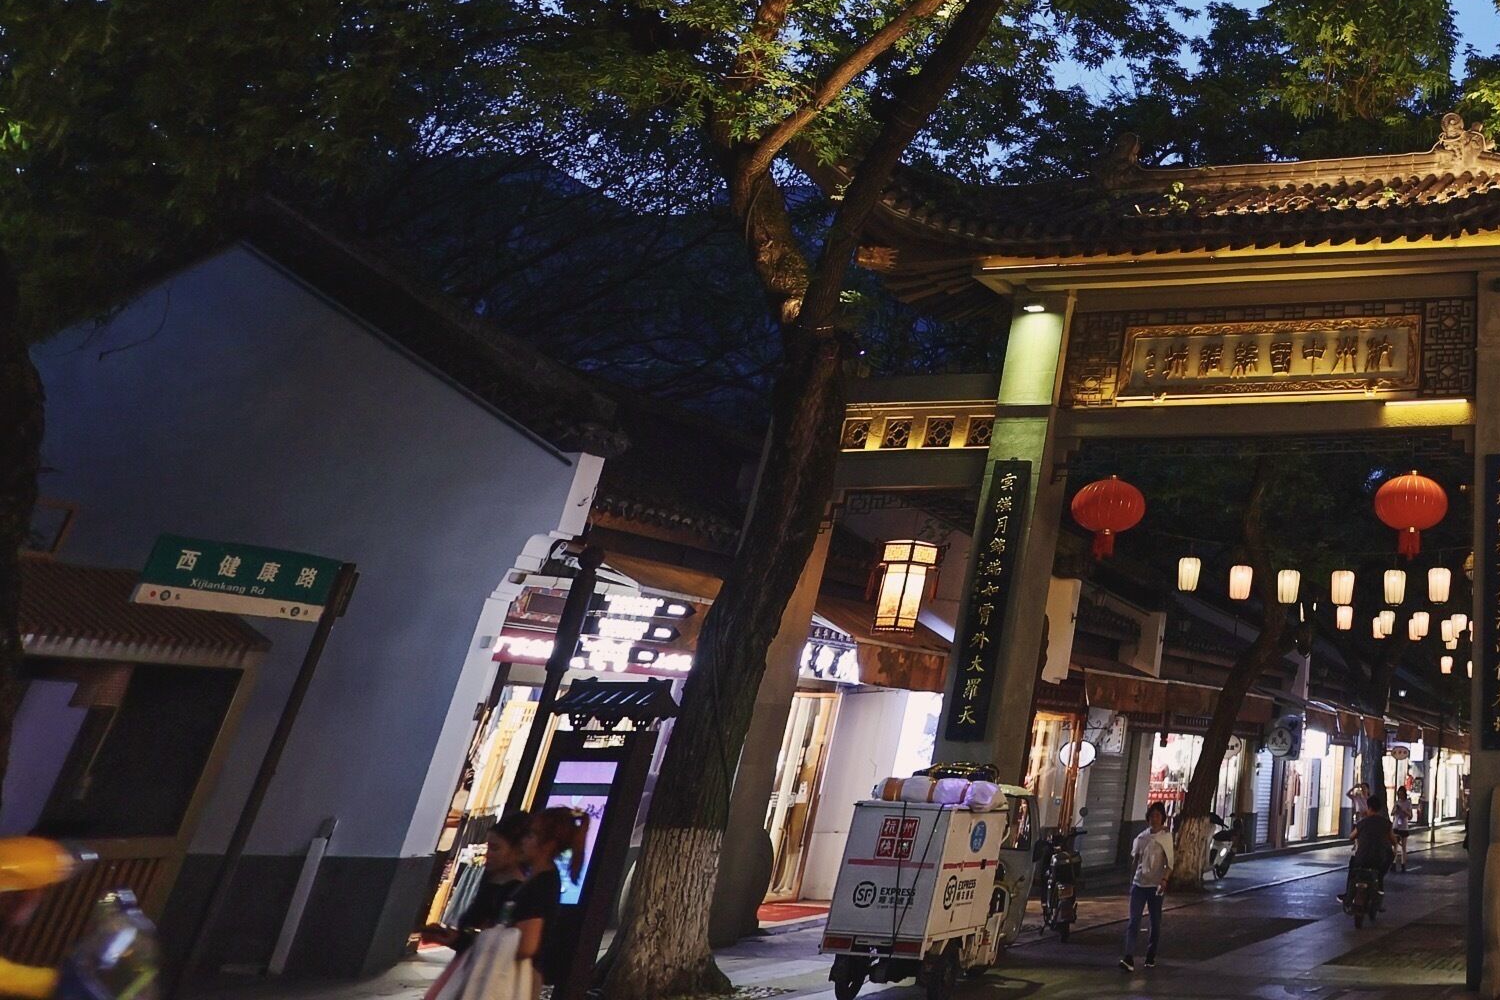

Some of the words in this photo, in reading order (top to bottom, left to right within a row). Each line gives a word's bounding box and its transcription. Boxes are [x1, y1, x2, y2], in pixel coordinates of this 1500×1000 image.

[175, 549, 318, 589] 西健康路
[189, 577, 246, 594] Xijiankang
[249, 586, 266, 595] Rd
[882, 818, 918, 839] 杭州
[880, 887, 917, 897] EXPRESS
[957, 878, 977, 891] EXPRESS
